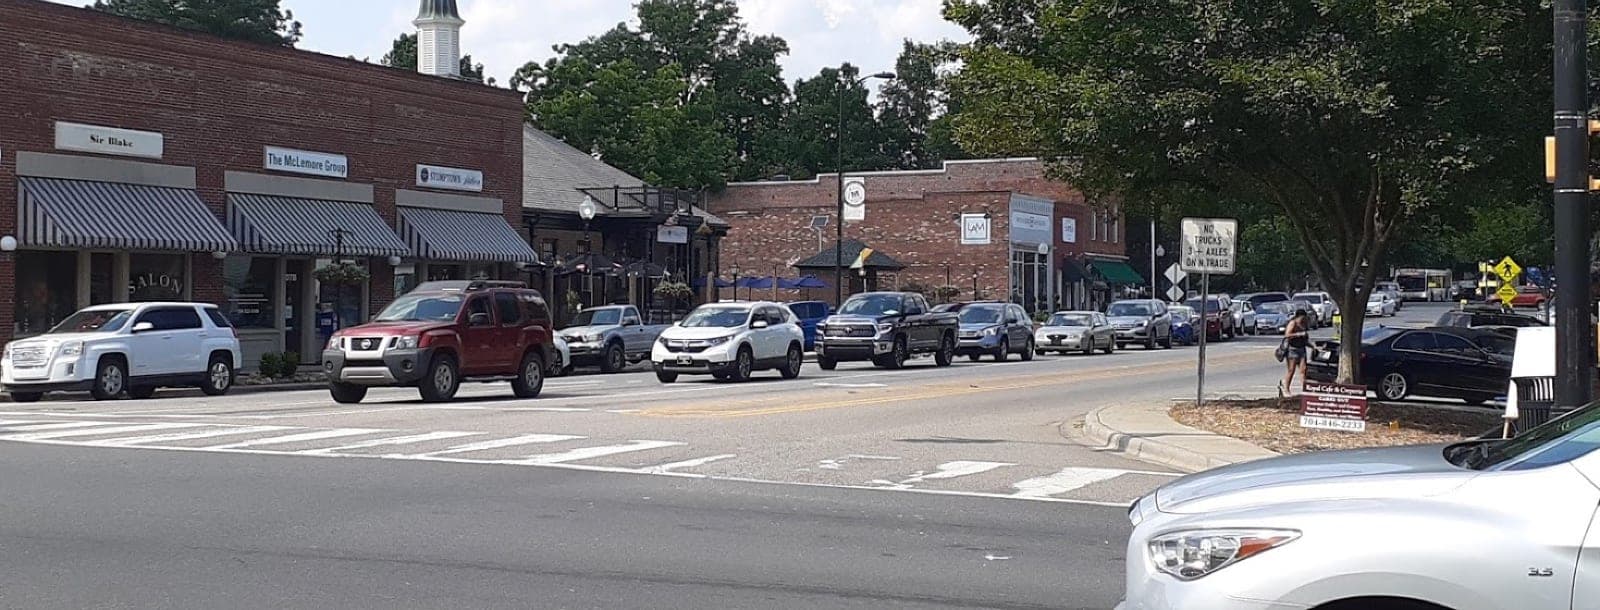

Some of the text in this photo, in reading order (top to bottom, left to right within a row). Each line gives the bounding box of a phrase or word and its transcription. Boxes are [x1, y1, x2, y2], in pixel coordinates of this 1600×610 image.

[90, 134, 133, 147] Sir Blake
[268, 153, 345, 176] The McLemore Group
[1203, 224, 1214, 234] NO
[1195, 235, 1222, 245] TRUCKS
[1188, 246, 1193, 255] 3
[1206, 247, 1228, 256] AXLES
[1186, 257, 1196, 267] ON
[1206, 258, 1229, 268] TRADE
[128, 273, 183, 295] SALON
[1305, 384, 1321, 392] Royal
